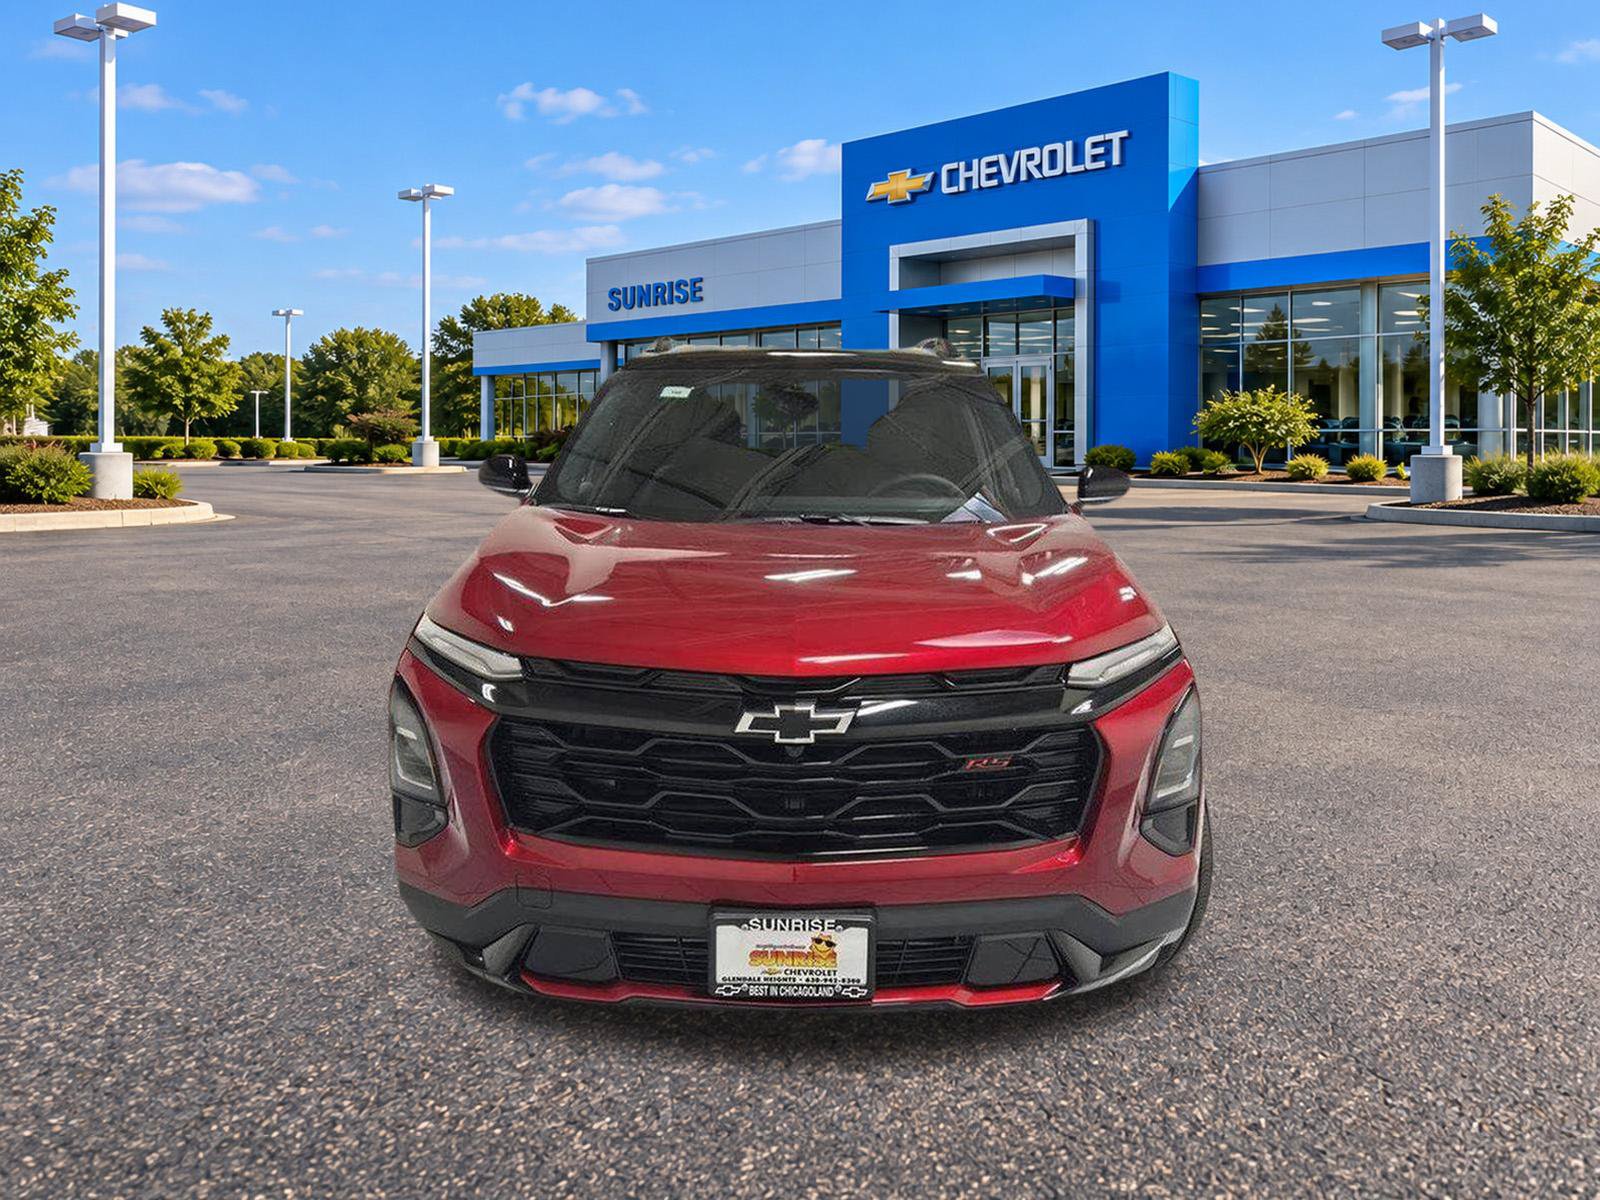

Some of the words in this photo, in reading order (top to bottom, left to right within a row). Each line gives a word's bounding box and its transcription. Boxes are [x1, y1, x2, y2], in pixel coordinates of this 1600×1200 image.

[941, 130, 1129, 194] CHEVROLET
[608, 277, 704, 312] SUNRISE
[964, 756, 1011, 771] RS
[750, 918, 835, 932] SUNRISE
[749, 950, 837, 967] SUNRISE
[783, 968, 838, 976] CHEVROLET
[749, 985, 768, 996] BEST
[769, 986, 778, 996] IN
[779, 985, 834, 997] CHICAGOLAND
